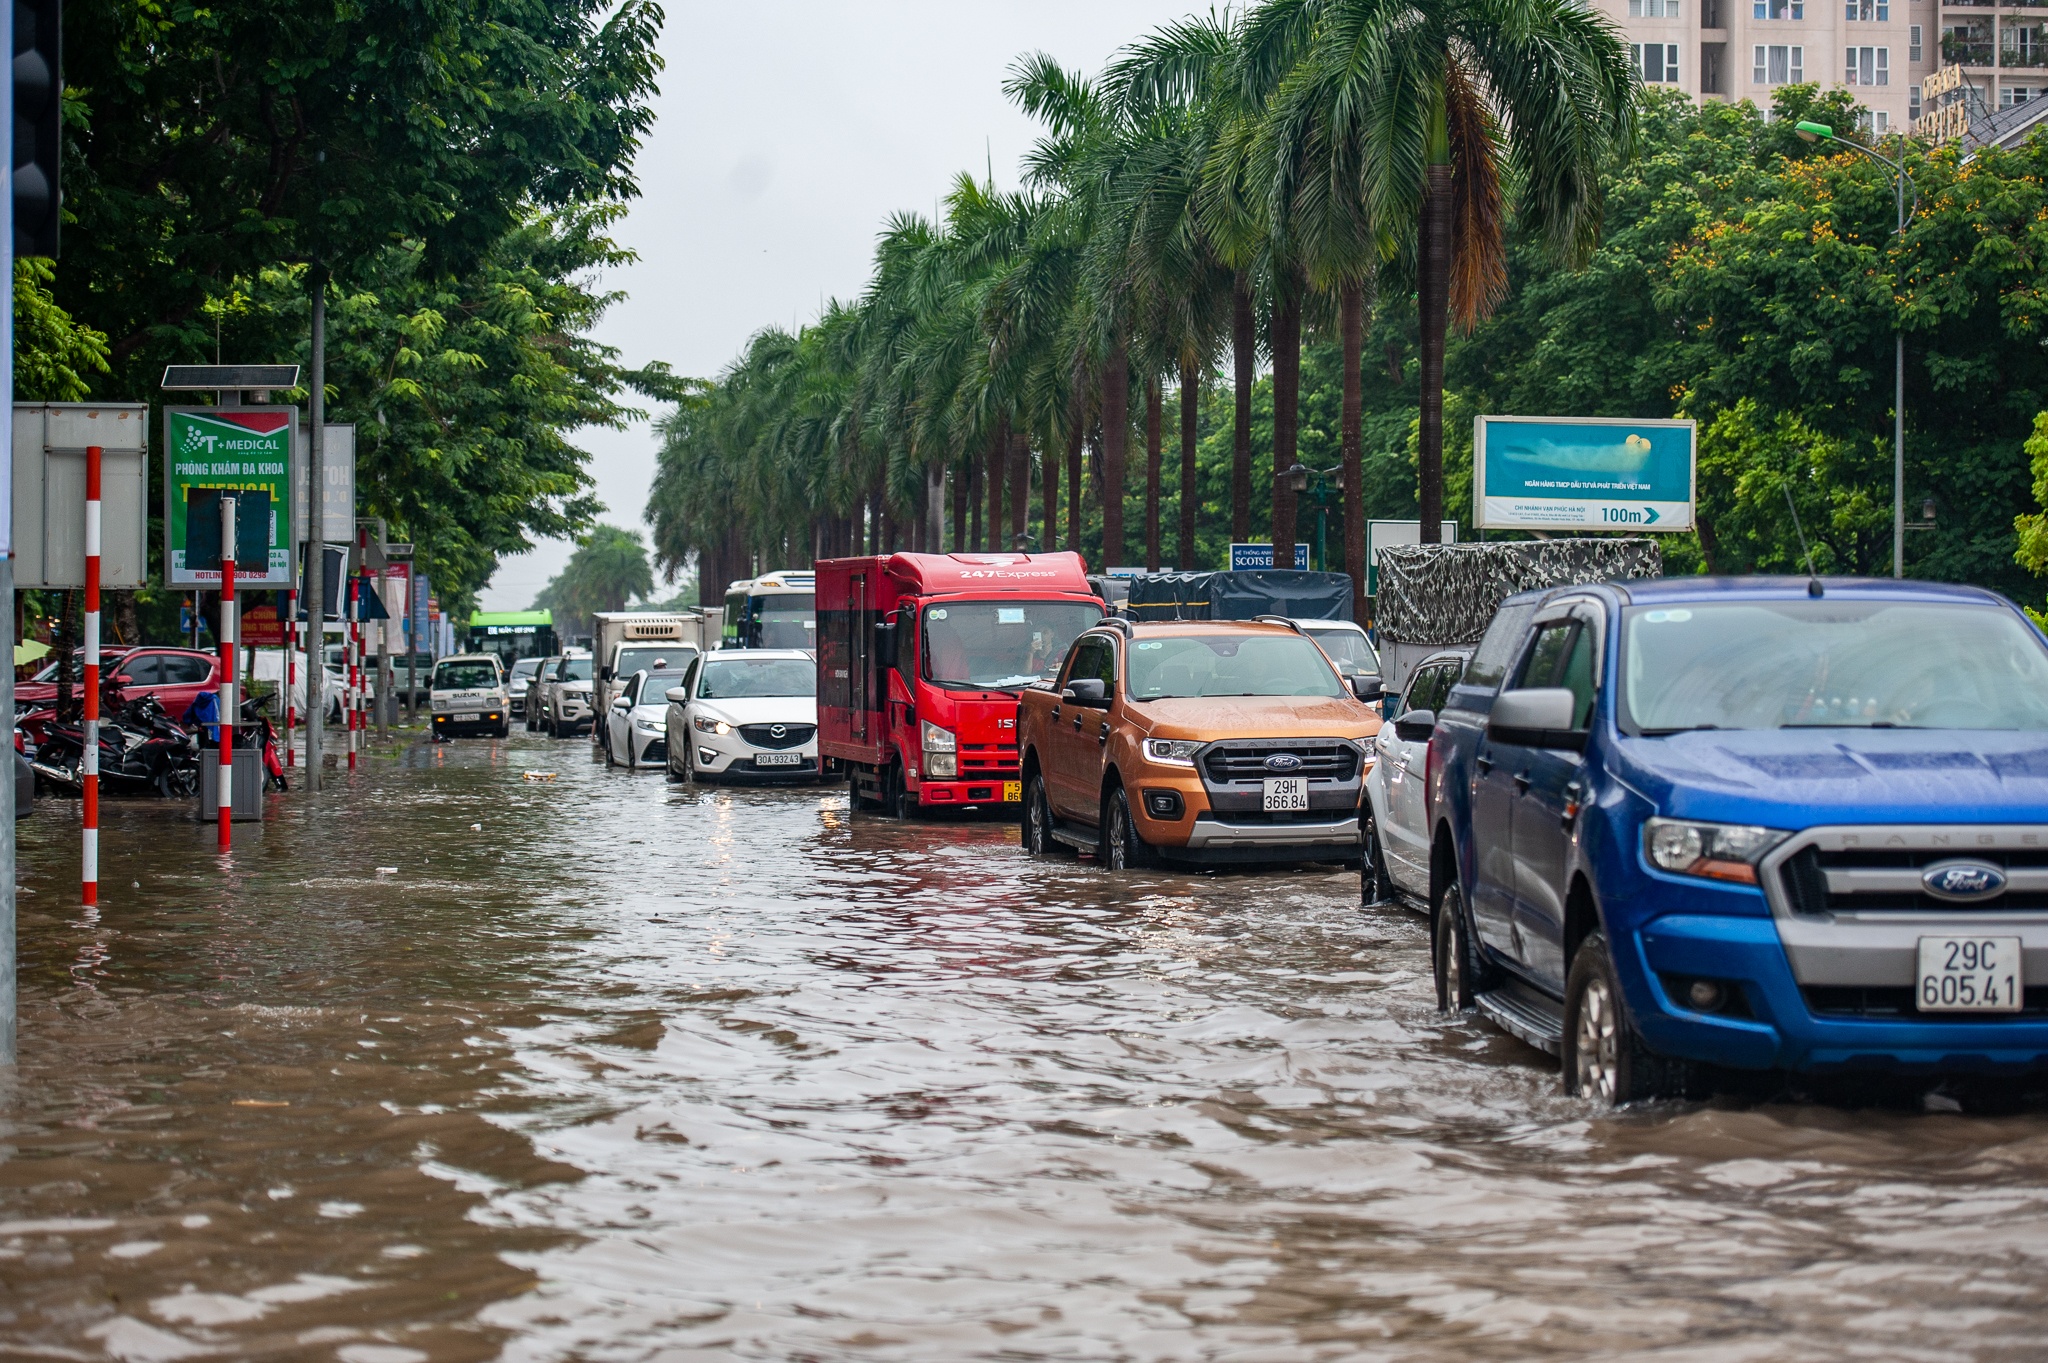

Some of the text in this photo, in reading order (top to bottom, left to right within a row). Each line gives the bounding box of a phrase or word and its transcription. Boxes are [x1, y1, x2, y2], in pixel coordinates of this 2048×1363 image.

[226, 440, 279, 450] MEDICAL
[176, 460, 284, 475] PHÒNG KHÁM ĐA KHOA
[1602, 508, 1641, 523] 100m
[1235, 557, 1264, 566] SCOTS
[960, 570, 1056, 580] 247Express
[1228, 740, 1336, 748] RANGER
[1273, 758, 1294, 768] Ford
[1274, 780, 1298, 794] 29H
[1265, 795, 1307, 809] 366.84
[1942, 869, 1989, 891] Ford
[1944, 940, 1996, 971] 29C
[1922, 975, 2015, 1006] 605.41
